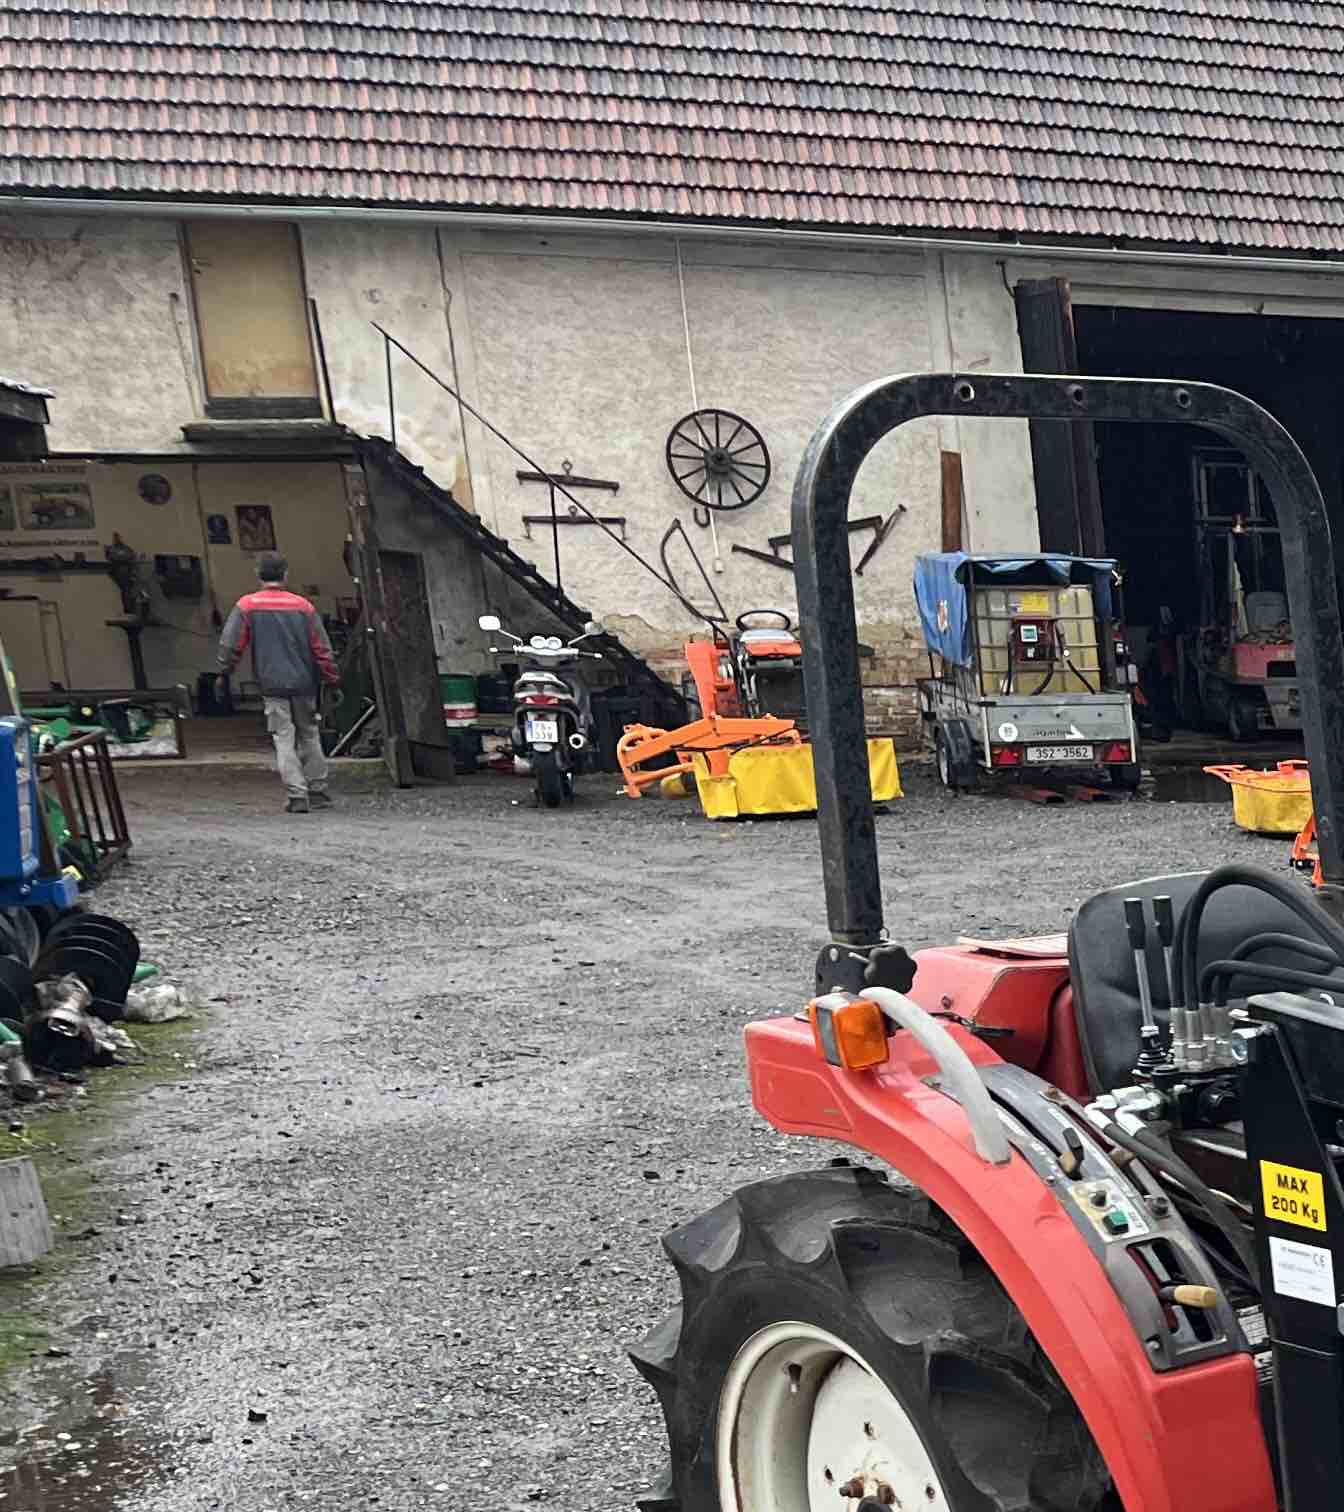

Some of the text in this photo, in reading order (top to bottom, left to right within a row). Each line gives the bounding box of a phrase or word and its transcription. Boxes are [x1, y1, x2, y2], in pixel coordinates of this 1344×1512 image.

[1276, 1172, 1310, 1195] MAX
[1271, 1195, 1319, 1224] 200 Kg
